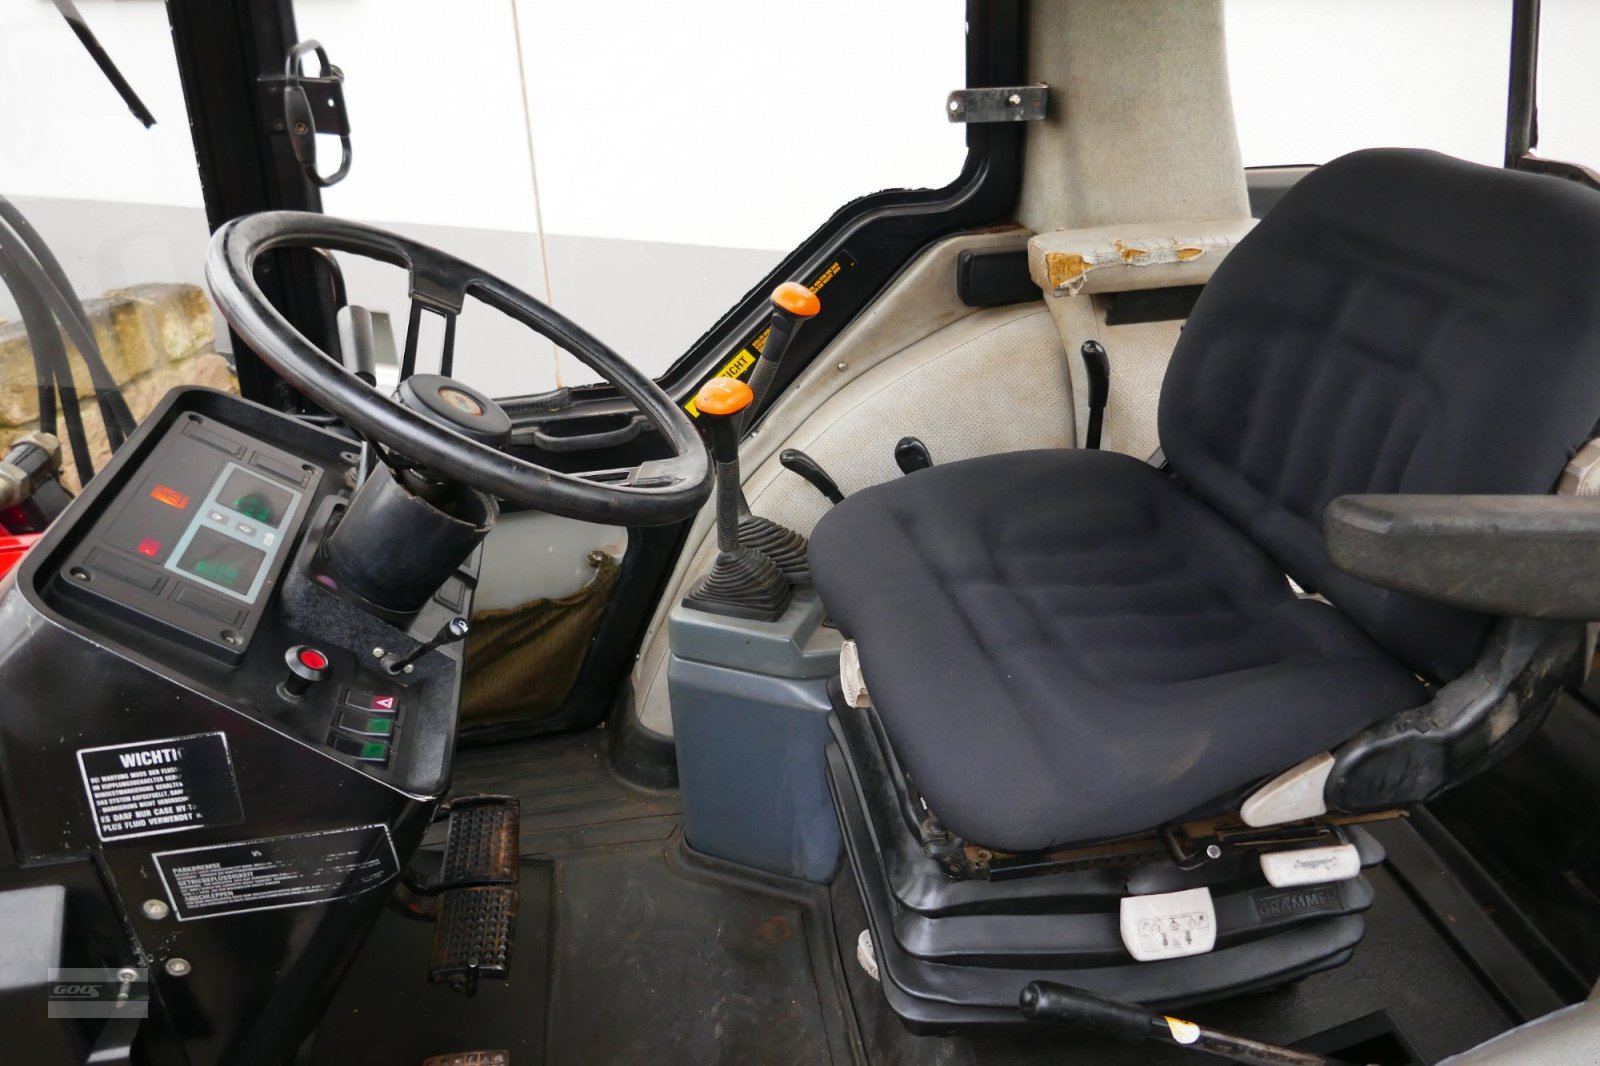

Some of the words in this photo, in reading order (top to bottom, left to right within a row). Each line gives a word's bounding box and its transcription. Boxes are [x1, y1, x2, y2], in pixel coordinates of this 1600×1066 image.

[139, 799, 156, 808] NICHT
[100, 815, 111, 823] ES
[114, 813, 133, 822] DARF
[135, 810, 152, 818] NUR
[154, 806, 173, 816] CASE
[102, 822, 123, 832] PLUS
[125, 819, 146, 829] FLUID
[148, 812, 193, 826] VERWENDET
